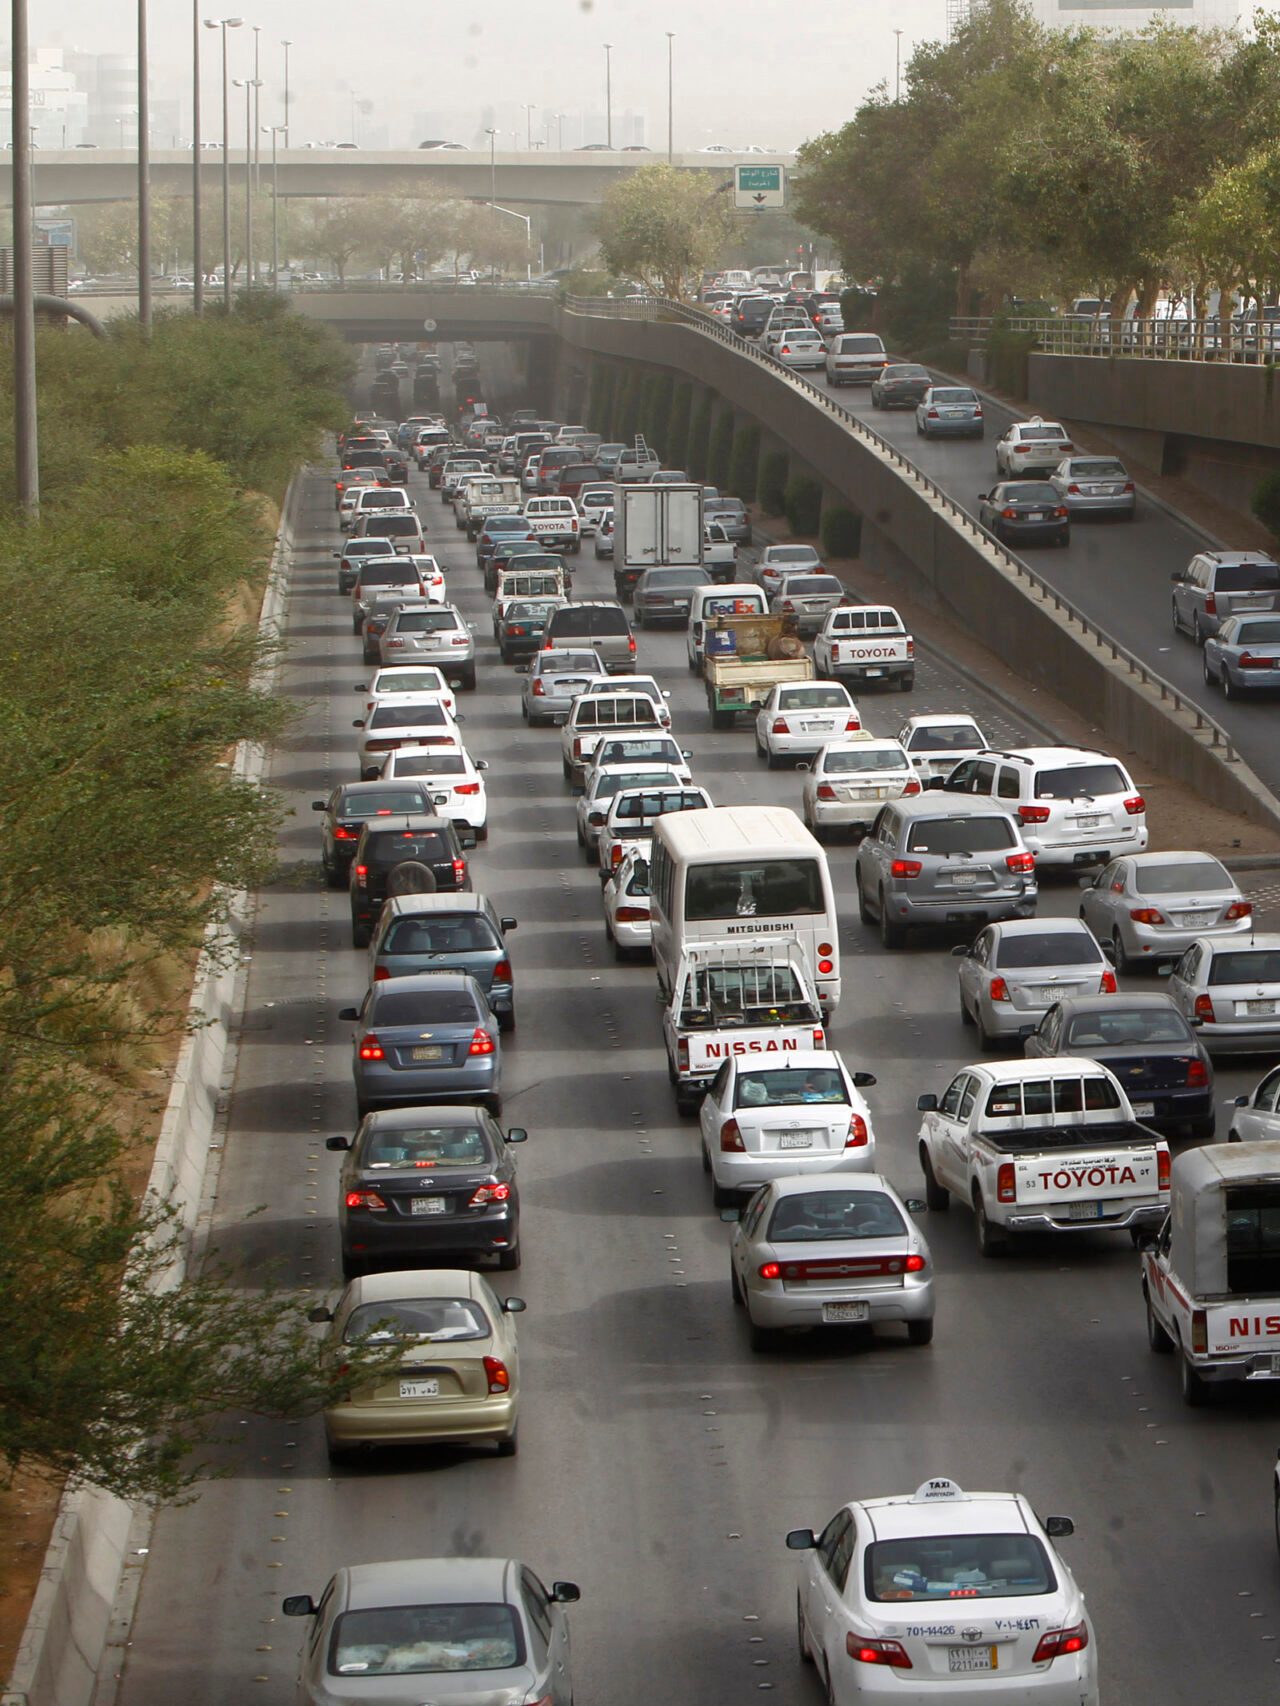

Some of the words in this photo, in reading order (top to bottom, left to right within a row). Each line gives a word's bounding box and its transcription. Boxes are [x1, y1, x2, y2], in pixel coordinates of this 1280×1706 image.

[533, 523, 565, 531] TOYOTA
[709, 599, 754, 615] FedEx
[850, 647, 896, 659] TOYOTA
[727, 922, 794, 934] MITSUBISHI
[706, 1038, 798, 1058] NISSAN
[1038, 1166, 1137, 1190] TOYOTA
[1026, 1180, 1036, 1188] 53
[929, 1481, 950, 1489] TAXI
[906, 1625, 956, 1636] 701-14426
[951, 1661, 972, 1671] 2211
